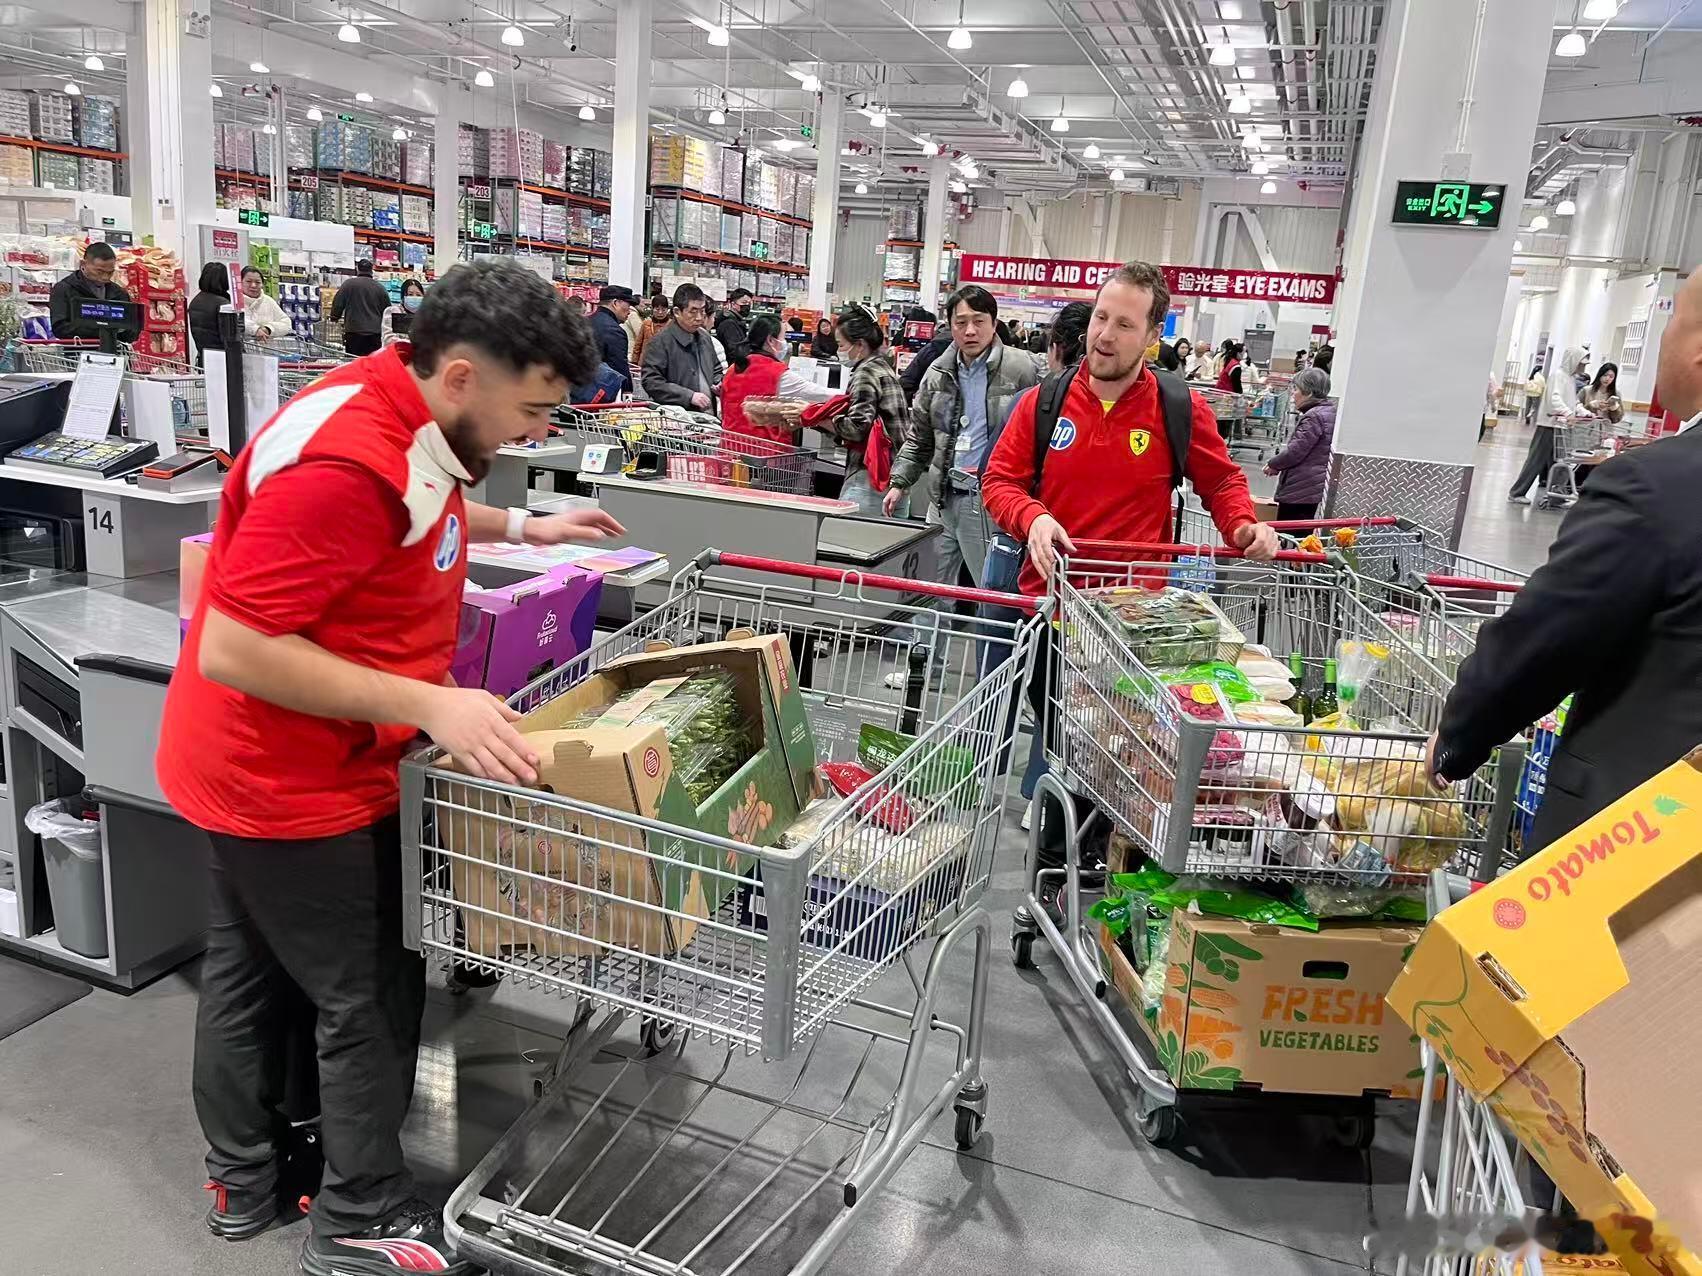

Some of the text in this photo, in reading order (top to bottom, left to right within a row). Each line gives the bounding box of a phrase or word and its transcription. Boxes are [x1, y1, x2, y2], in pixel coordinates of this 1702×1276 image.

[302, 176, 317, 188] 205
[475, 186, 490, 198] 203
[972, 260, 1047, 282] HEARING
[1052, 265, 1080, 284] AID
[1178, 272, 1230, 294] 验光室
[1234, 275, 1327, 299] EYE EXAMS
[88, 506, 115, 534] 14
[1528, 810, 1661, 902] Tomato
[1262, 985, 1385, 1026] FRESH
[1260, 1030, 1380, 1053] VEGETABLES
